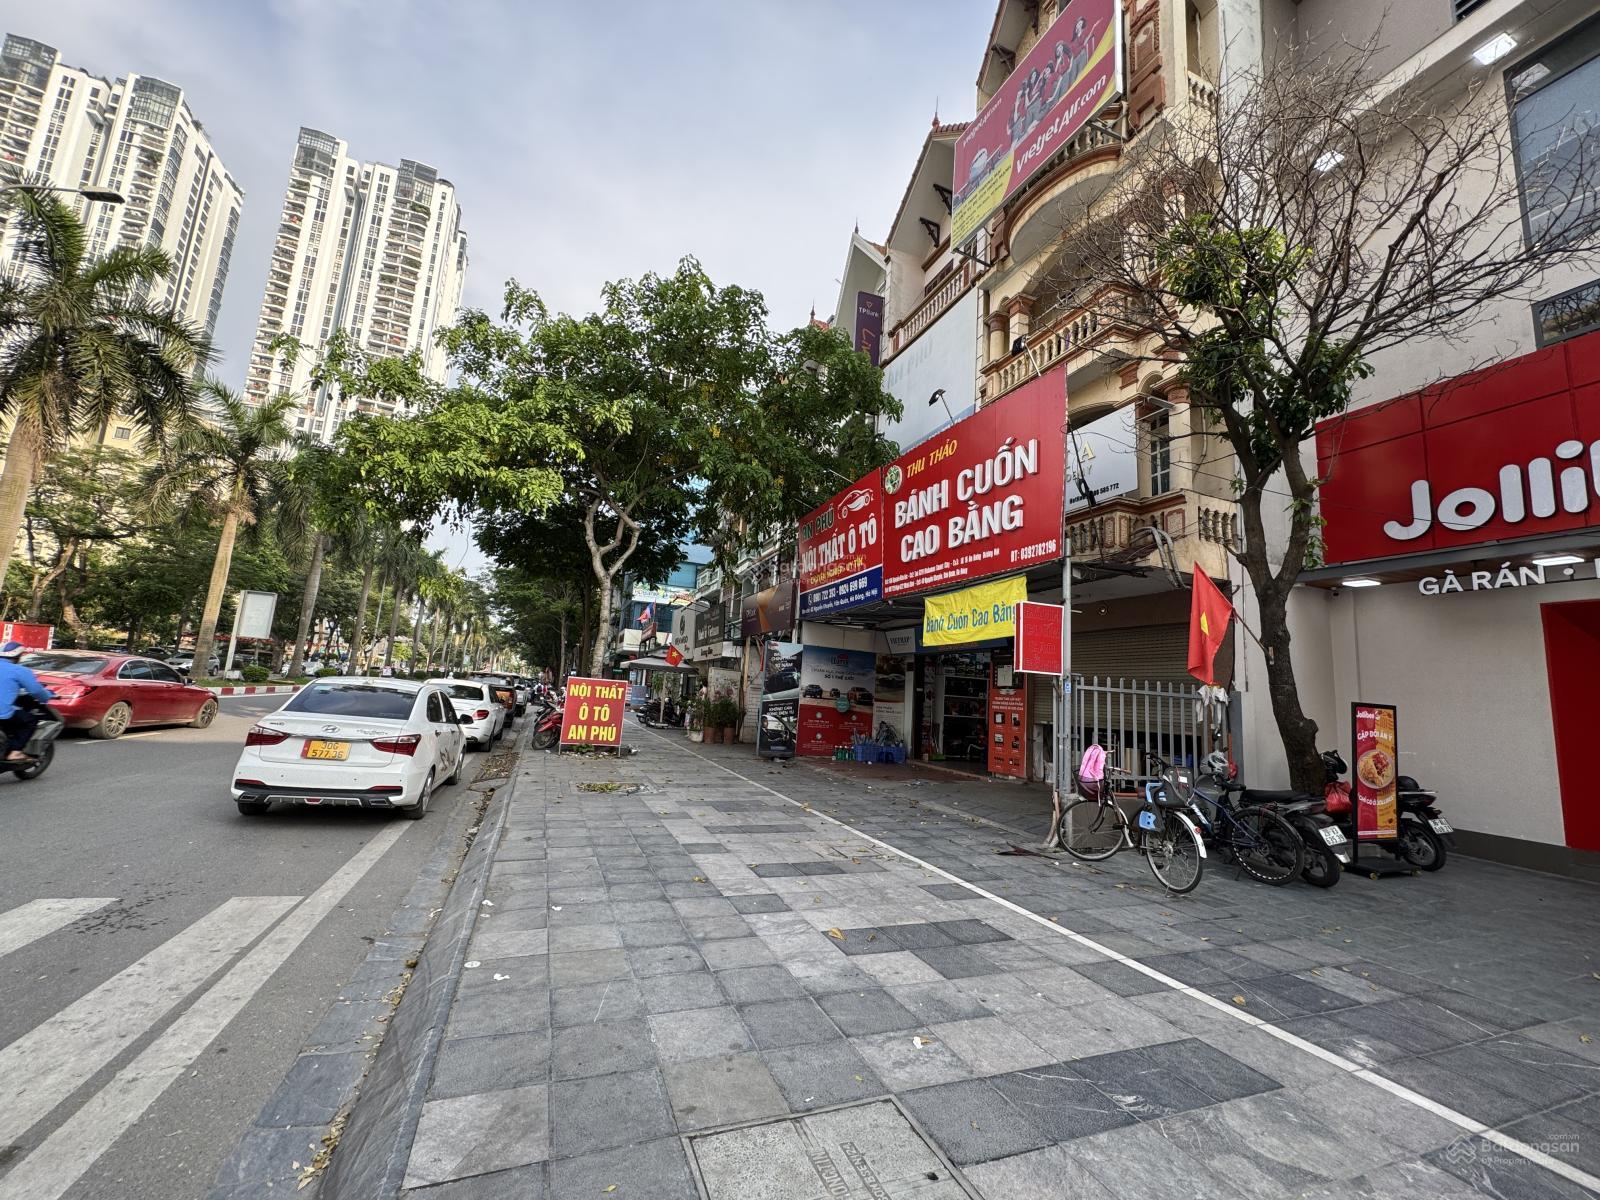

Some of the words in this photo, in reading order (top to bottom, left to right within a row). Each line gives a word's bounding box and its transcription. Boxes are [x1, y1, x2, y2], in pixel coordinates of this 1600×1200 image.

[906, 457, 926, 478] THU
[929, 439, 958, 465] THẢO
[895, 479, 949, 528] BÁNH
[956, 436, 1038, 501] CUỐN
[900, 524, 940, 563] CAO
[948, 494, 1024, 548] BẰNG
[801, 545, 816, 576] NỘI
[818, 528, 846, 566] THẤT
[848, 523, 856, 554] Ô
[859, 512, 877, 548] TÔ
[1418, 569, 1464, 595] GÀ
[1471, 561, 1546, 591] RÁN
[925, 616, 944, 633] Bánh
[947, 608, 969, 631] Cuốn
[972, 608, 989, 628] Cao
[570, 682, 591, 700] NỘI
[595, 683, 624, 700] THẤT
[578, 702, 589, 720] Ô
[593, 704, 610, 722] TÔ
[568, 725, 587, 740] AN
[590, 724, 616, 741] PHÚ
[1357, 730, 1369, 741] CẶP
[1369, 728, 1379, 738] ĐÔI
